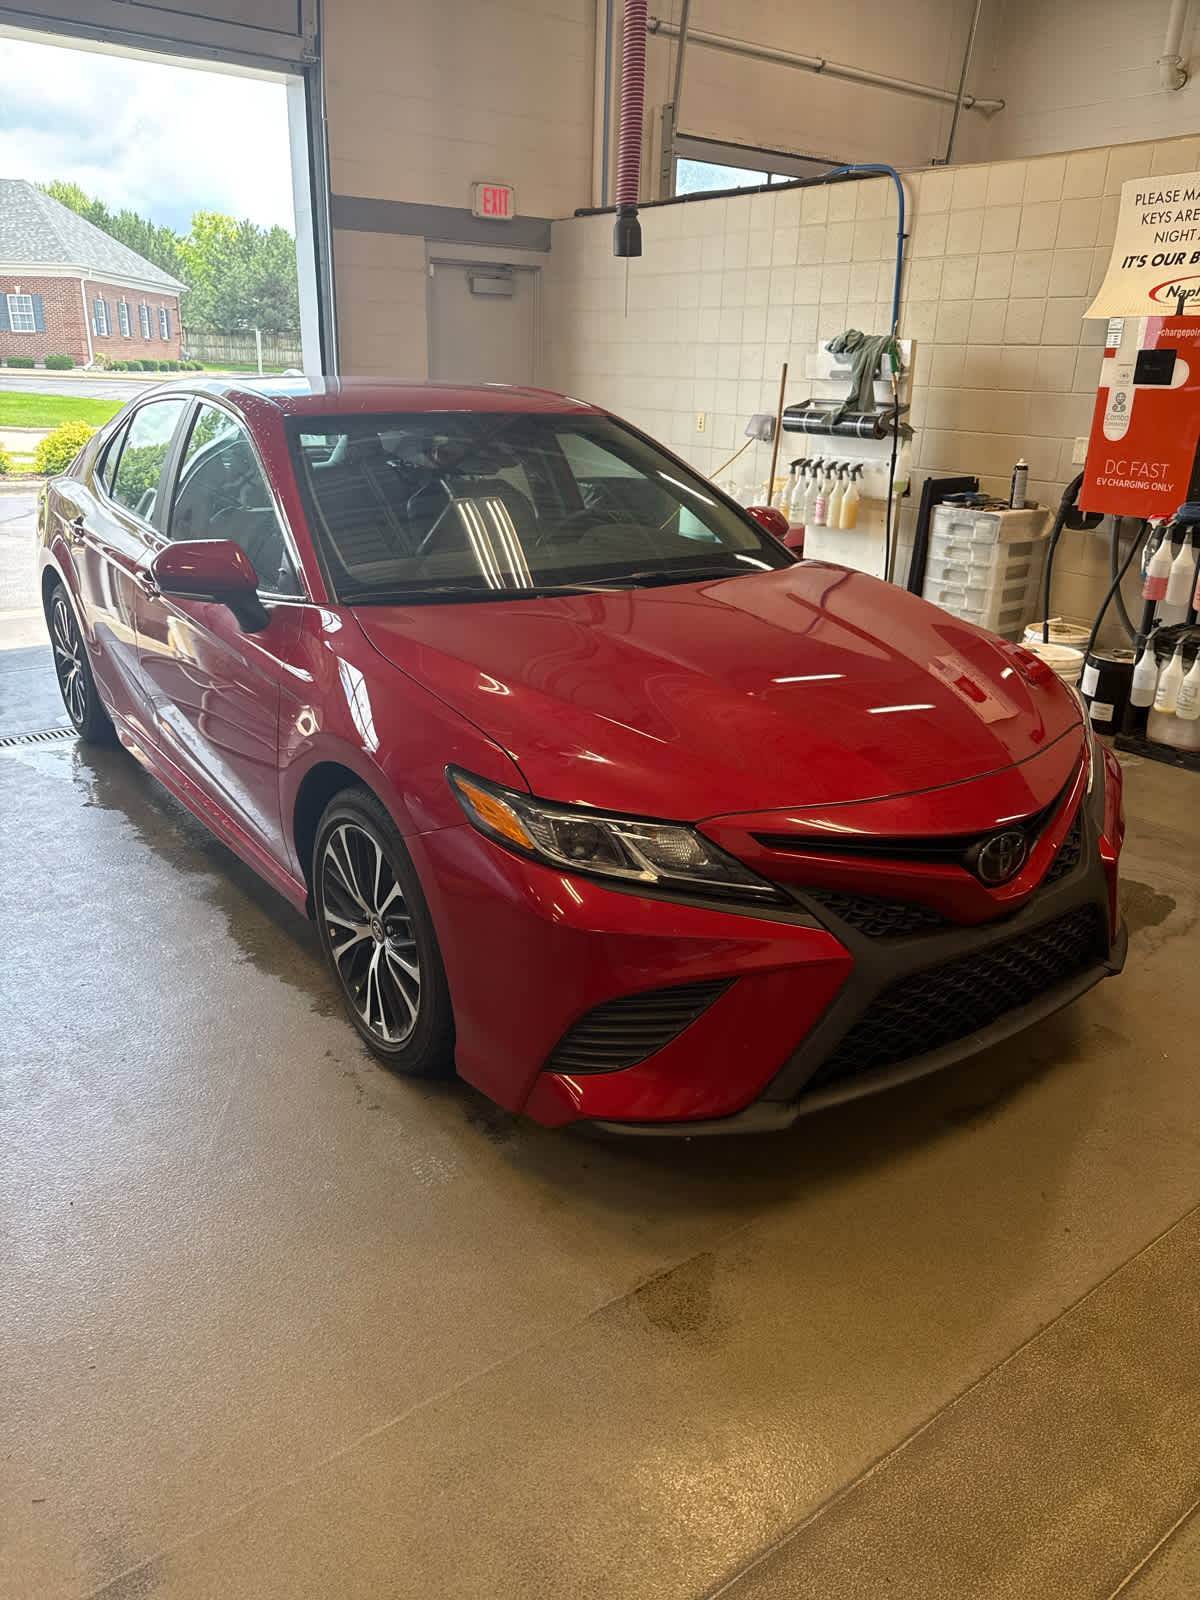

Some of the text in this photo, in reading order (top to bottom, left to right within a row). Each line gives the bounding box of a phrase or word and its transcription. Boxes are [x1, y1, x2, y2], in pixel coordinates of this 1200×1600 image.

[483, 187, 509, 216] EXIT
[1136, 190, 1180, 206] PLEASE
[1141, 208, 1200, 225] KEYS ARE
[1154, 228, 1197, 244] NIGHT
[1121, 254, 1148, 269] IT'S
[1151, 252, 1187, 267] OUR
[1104, 459, 1170, 479] DC FAST
[1096, 477, 1175, 492] EV CHARGING ONLY
